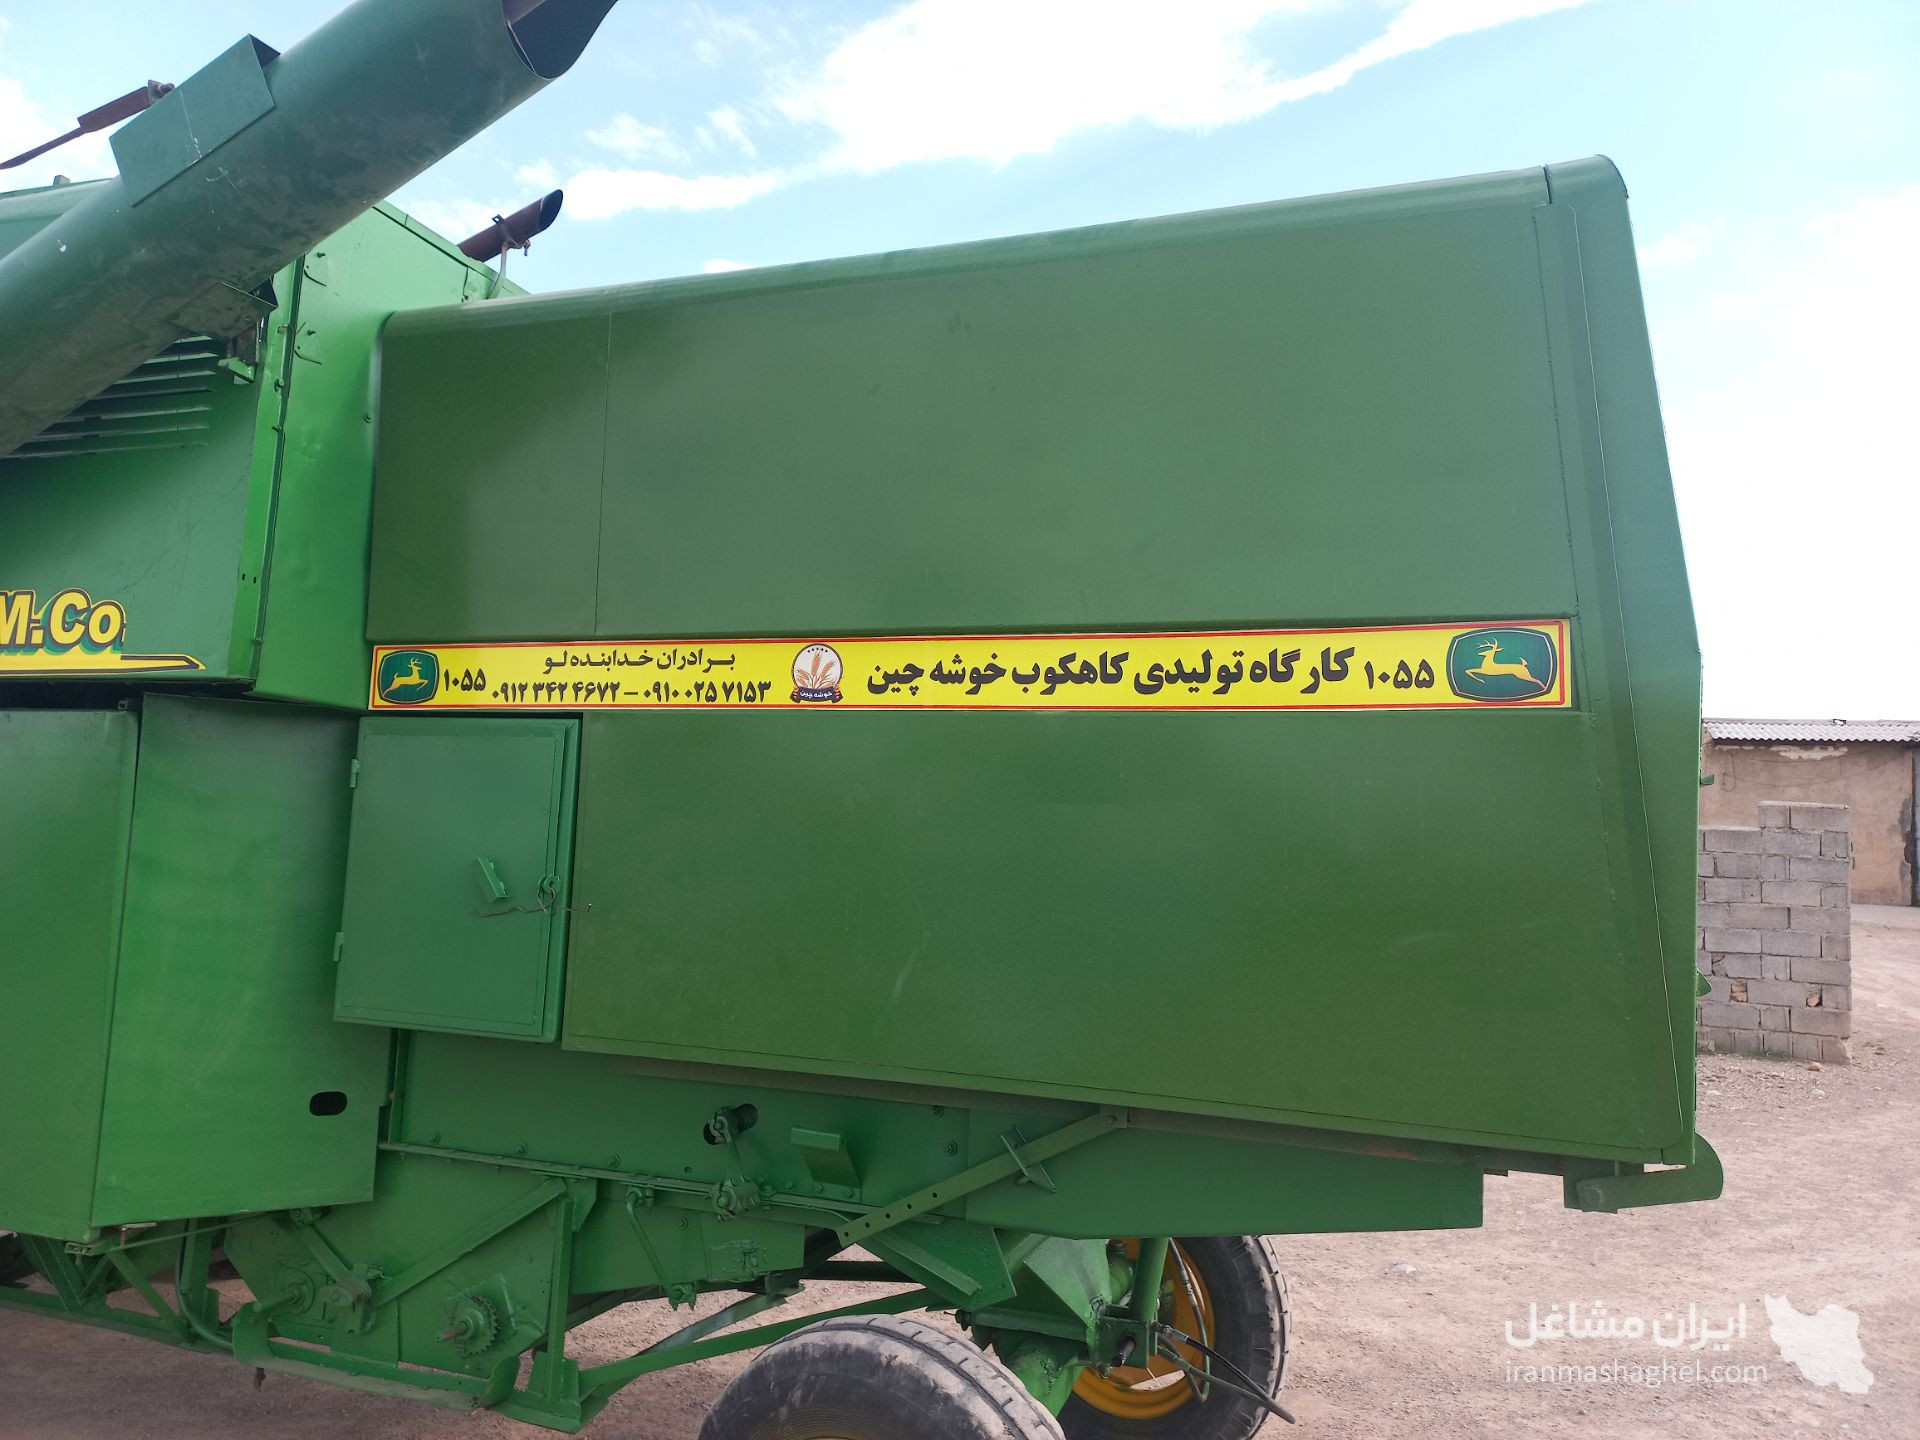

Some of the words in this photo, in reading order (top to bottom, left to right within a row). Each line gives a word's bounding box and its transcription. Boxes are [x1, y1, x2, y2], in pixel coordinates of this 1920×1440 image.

[570, 648, 654, 672] خدابنده
[656, 648, 736, 674] برادران
[929, 652, 1007, 696] خوشه
[1011, 651, 1130, 696] کاهکوب
[1133, 649, 1245, 696] تولیدی
[1249, 647, 1356, 695] کارگاه
[1363, 658, 1435, 690] ۱۰۵۵
[443, 668, 487, 692] ۱۰۵۵
[866, 662, 925, 697] چین
